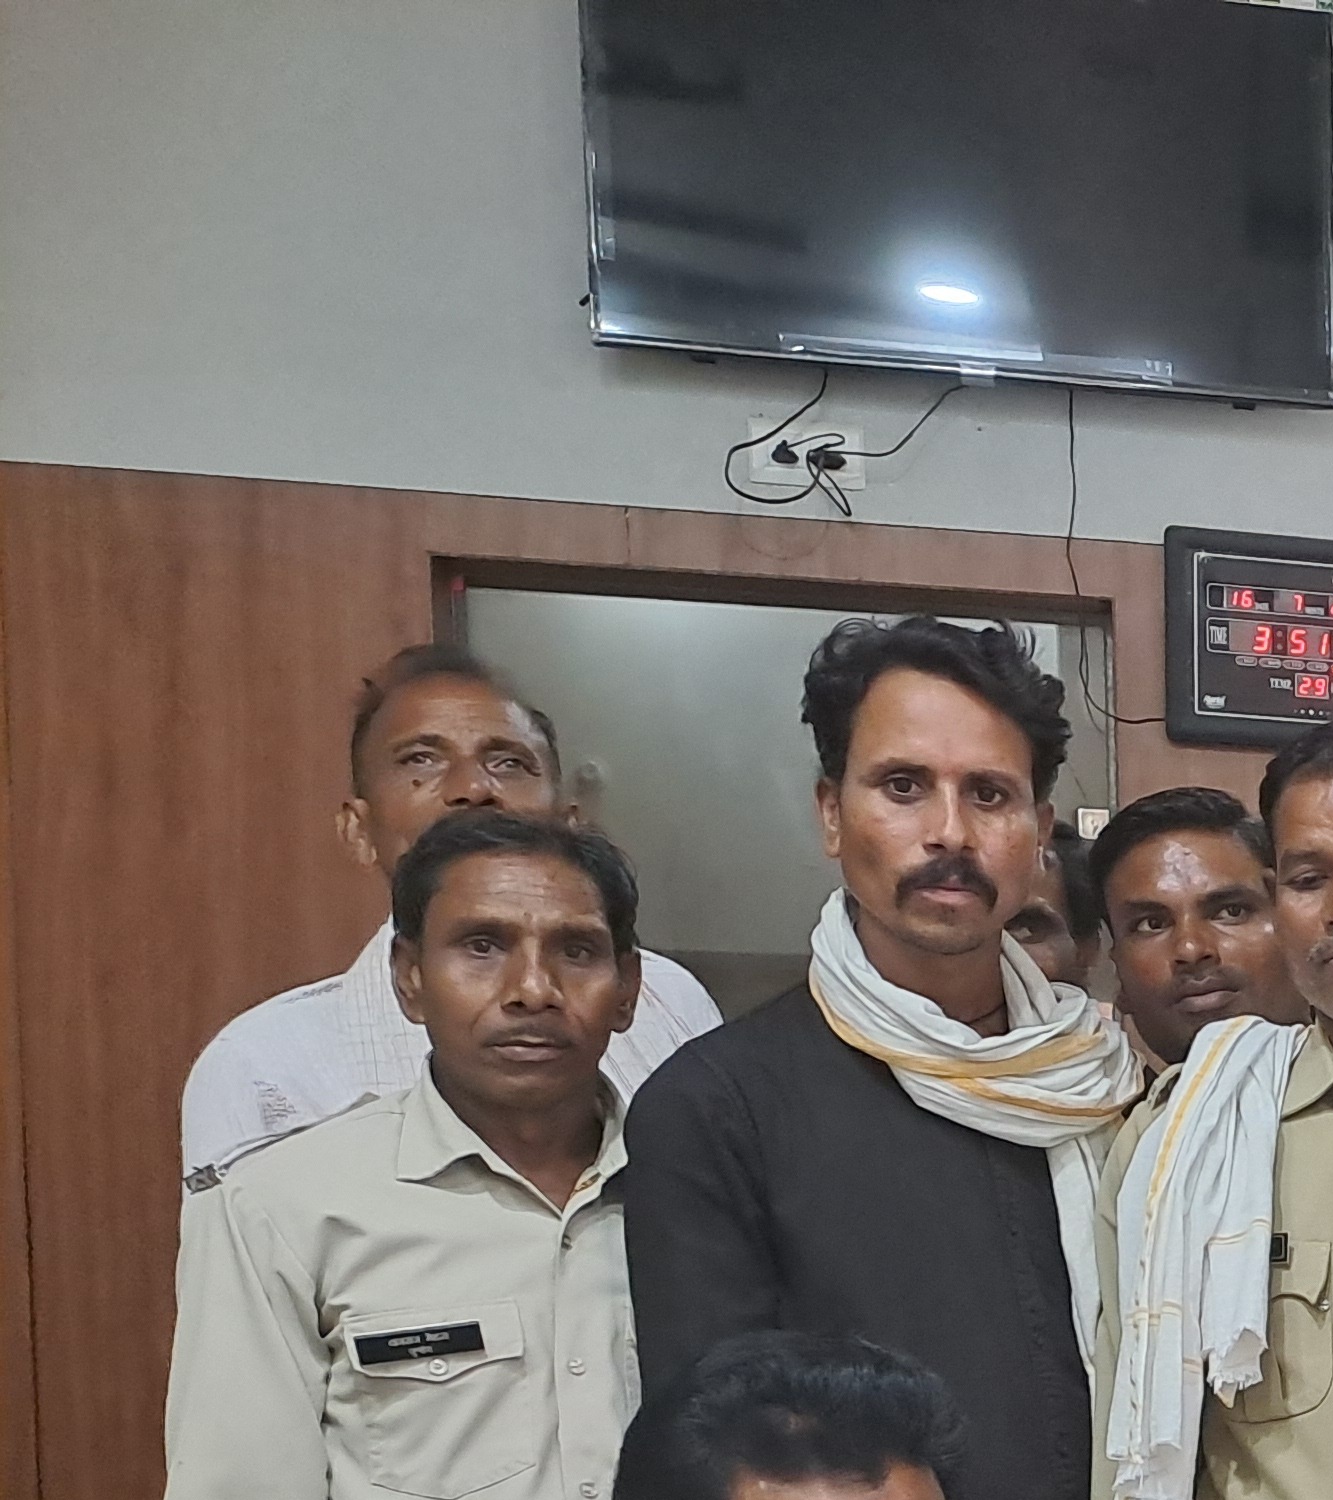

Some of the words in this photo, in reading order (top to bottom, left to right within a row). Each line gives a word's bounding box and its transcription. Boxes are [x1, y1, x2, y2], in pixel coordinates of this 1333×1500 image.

[1232, 590, 1254, 609] 16
[1293, 594, 1303, 612] 7
[1299, 676, 1326, 696] 29
